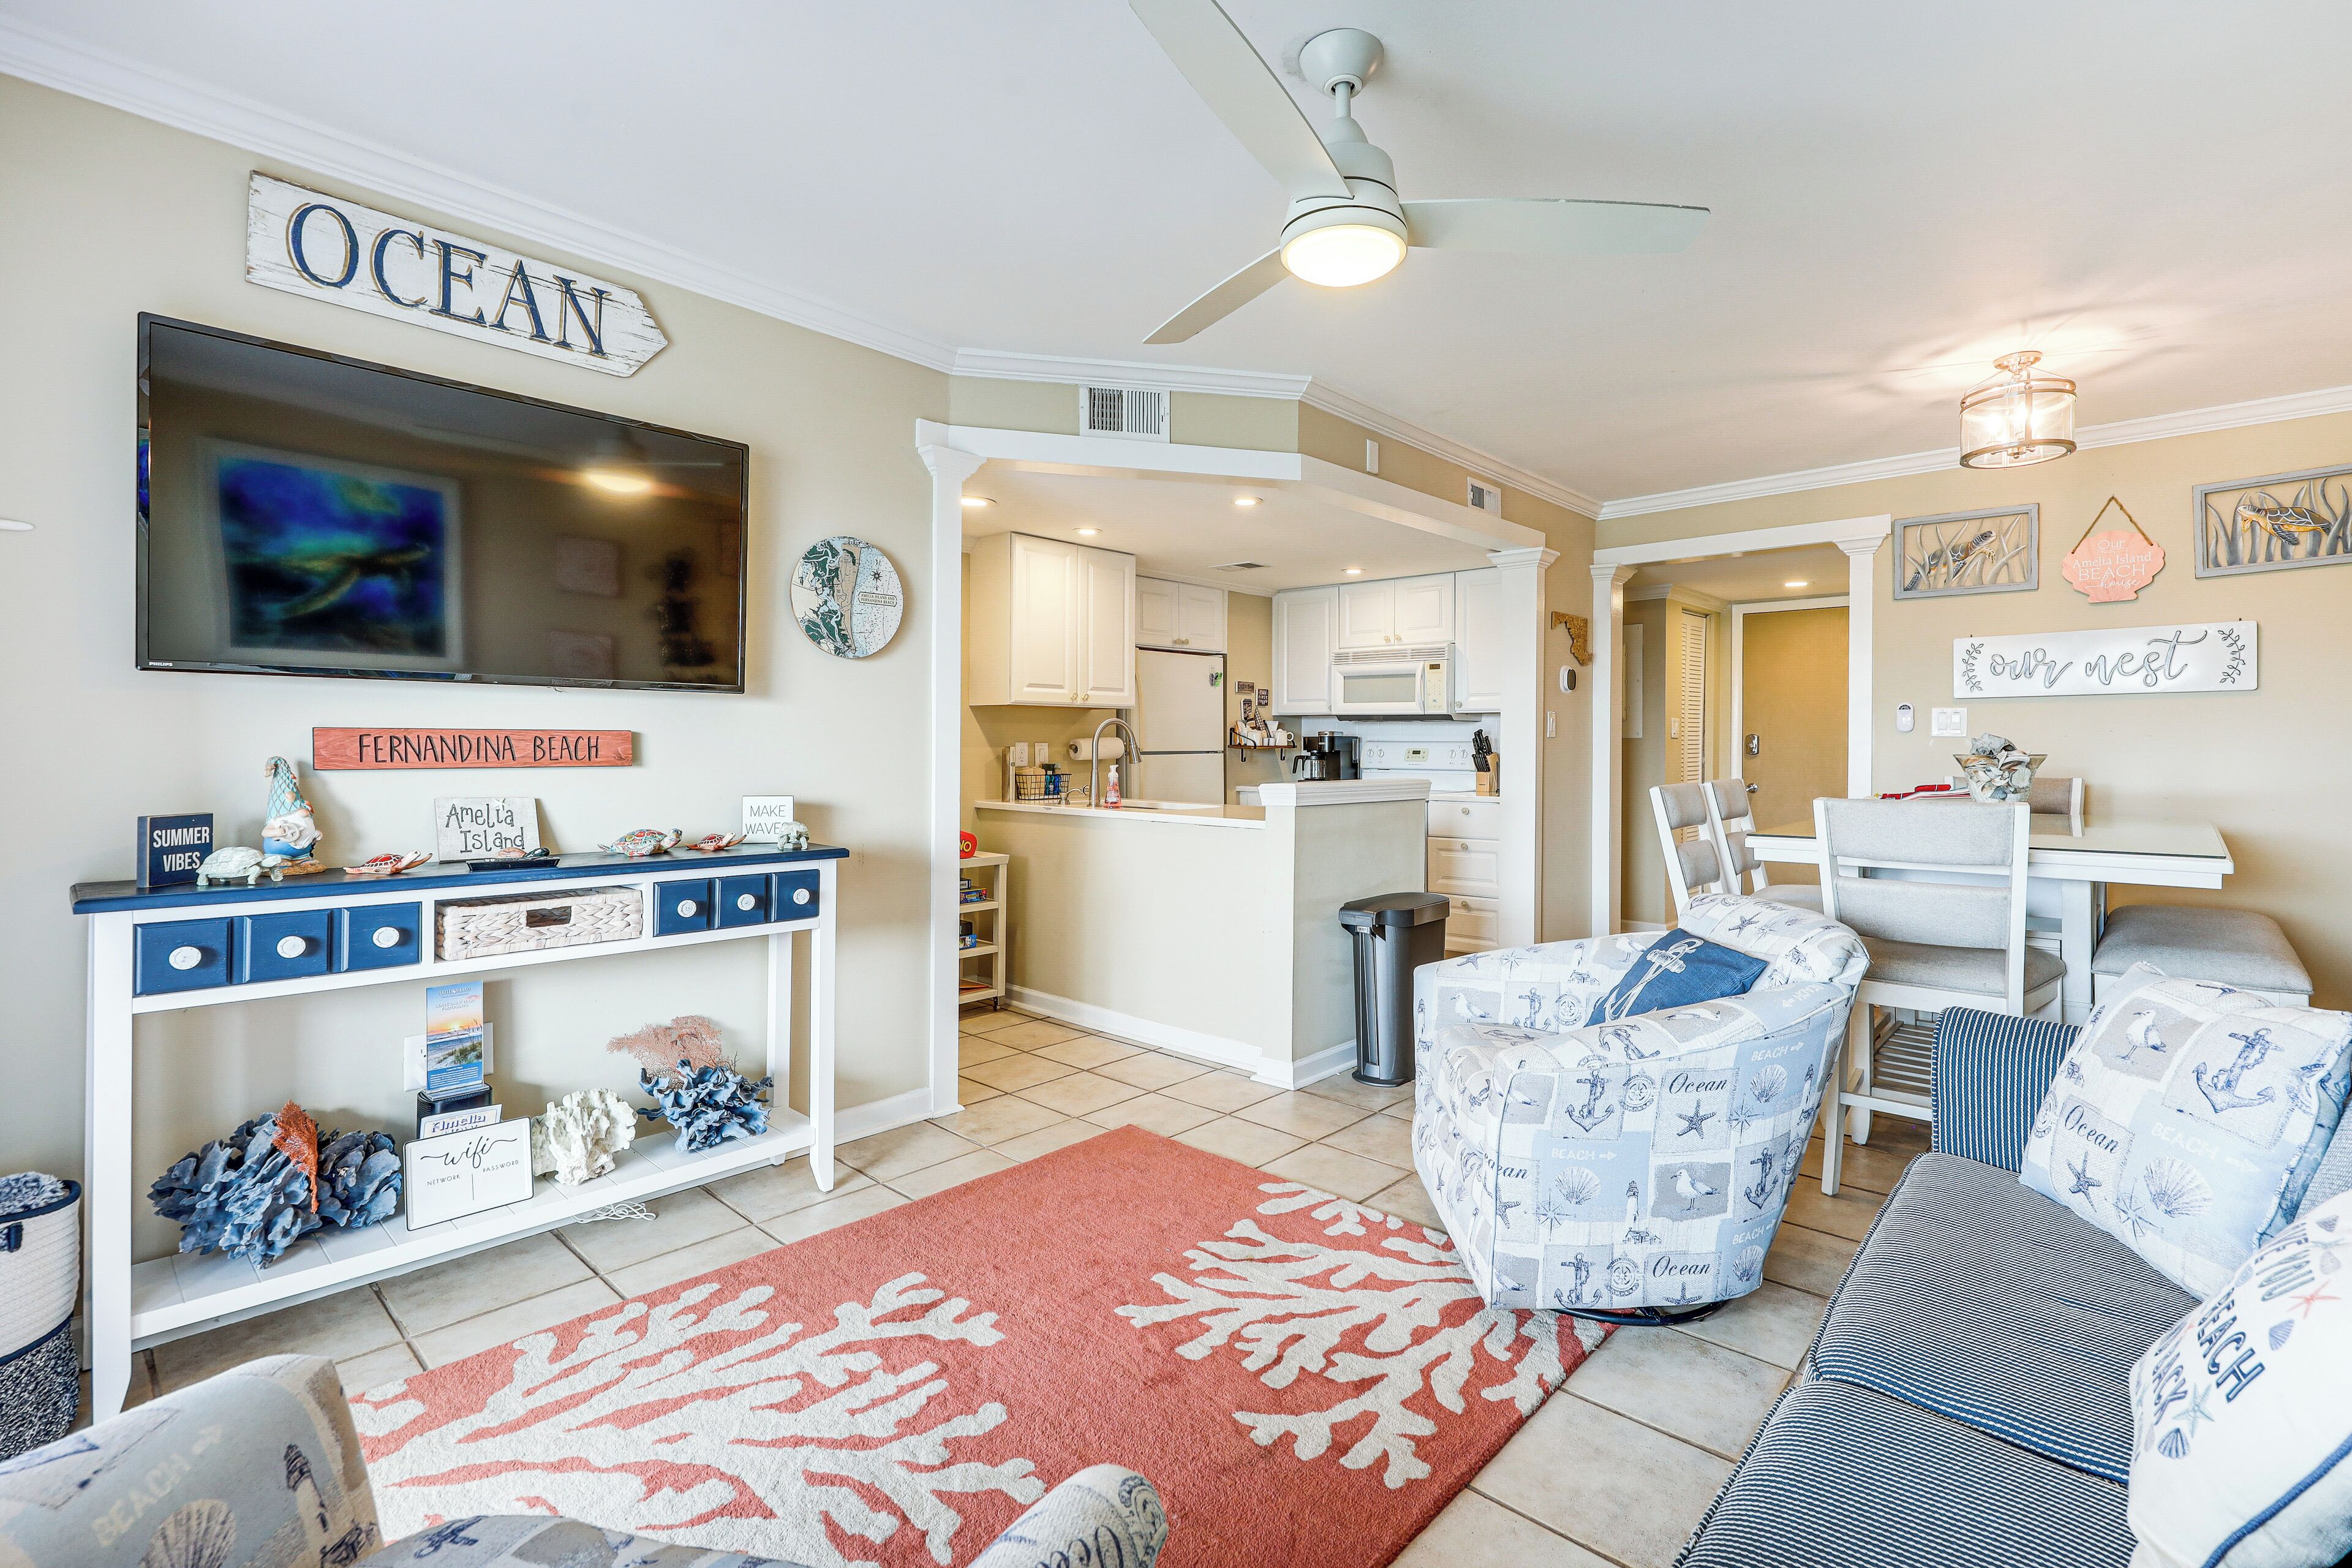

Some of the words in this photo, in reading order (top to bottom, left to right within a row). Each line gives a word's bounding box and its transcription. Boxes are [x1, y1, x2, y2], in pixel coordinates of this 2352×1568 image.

[285, 203, 611, 358] OCEAN
[2097, 539, 2126, 550] Our
[2073, 556, 2113, 568] Amelia
[2116, 551, 2152, 564] Island
[2078, 564, 2145, 581] BEACH
[2085, 575, 2141, 589] house
[1990, 648, 2072, 689] our
[2085, 630, 2207, 687] nest
[359, 734, 516, 763] FERNANDINA
[533, 736, 599, 762] BEACH
[445, 803, 515, 829] Amelia
[749, 804, 786, 818] MAKE
[153, 826, 209, 848] SUMMER
[460, 826, 526, 854] Island
[162, 851, 200, 873] VIBES
[1751, 1046, 1788, 1061] BEACH
[1668, 1072, 1728, 1095] Ocean
[431, 1114, 486, 1133] Amelia
[2064, 1104, 2120, 1155] Ocean
[420, 1136, 518, 1169] wifi
[2152, 1121, 2219, 1162] BEACH
[1551, 1148, 1596, 1161] BEACH
[483, 1159, 519, 1173] PASSWORD
[427, 1174, 461, 1186] NETWORK
[1732, 1226, 1765, 1245] BEACH
[1653, 1255, 1711, 1278] Ocean
[2196, 1287, 2265, 1404] BEACH
[91, 1452, 192, 1547] BEACH
